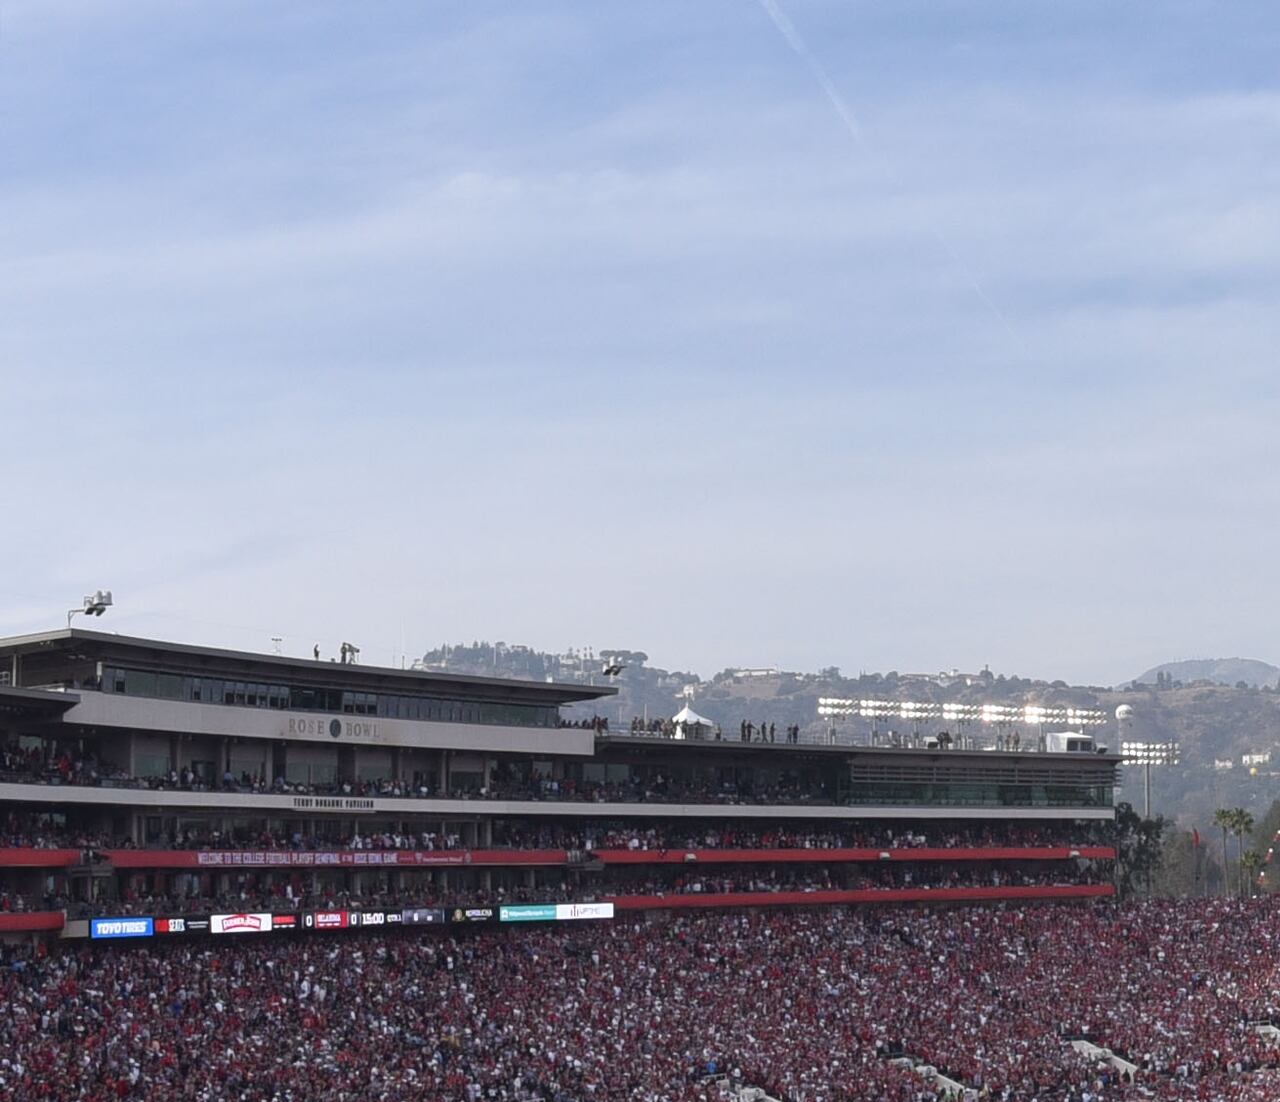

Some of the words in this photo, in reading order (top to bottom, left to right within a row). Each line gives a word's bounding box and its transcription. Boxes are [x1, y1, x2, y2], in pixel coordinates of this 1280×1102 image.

[289, 718, 325, 735] ROSE
[345, 722, 380, 738] BOWL
[362, 913, 384, 925] 15:00
